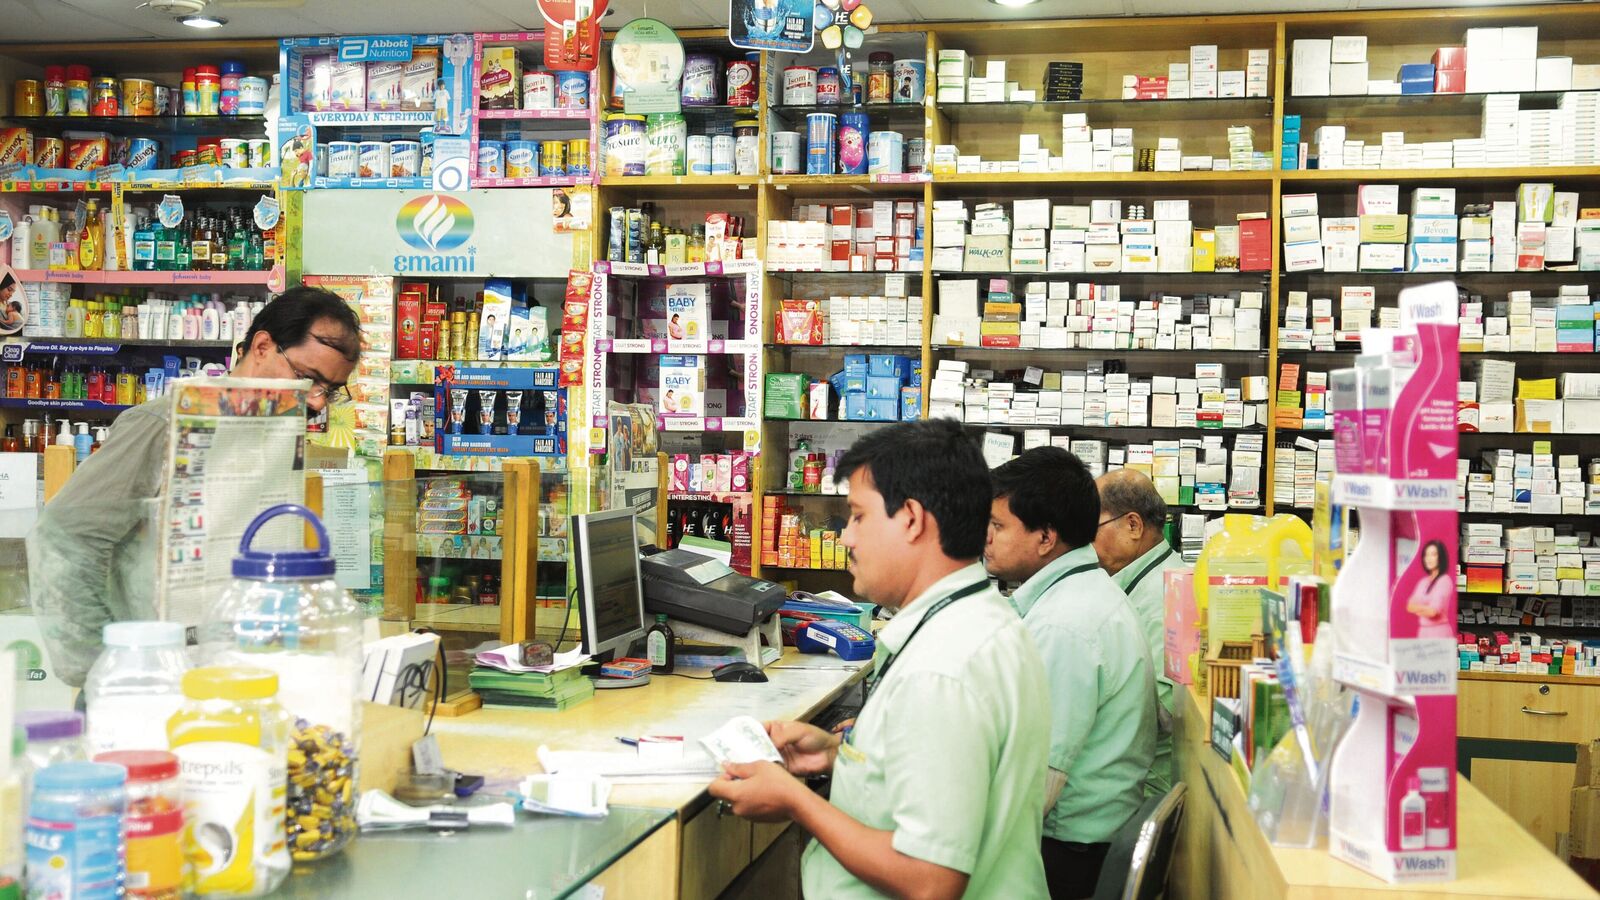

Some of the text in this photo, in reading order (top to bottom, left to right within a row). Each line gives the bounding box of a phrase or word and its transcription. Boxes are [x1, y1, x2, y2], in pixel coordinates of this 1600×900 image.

[835, 12, 849, 23] HE
[371, 39, 409, 48] Abbott
[369, 49, 409, 58] Nutrition
[313, 112, 370, 122] EVERYDAY
[968, 249, 1004, 258] WALK-ON
[594, 276, 602, 318] STRONG
[668, 297, 697, 308] BABY
[749, 293, 758, 335] STRONG
[593, 354, 602, 388] STRON
[665, 376, 691, 385] BABY
[682, 524, 695, 534] HE
[704, 524, 716, 534] HE
[30, 671, 43, 679] fat
[182, 760, 243, 778] trepsils
